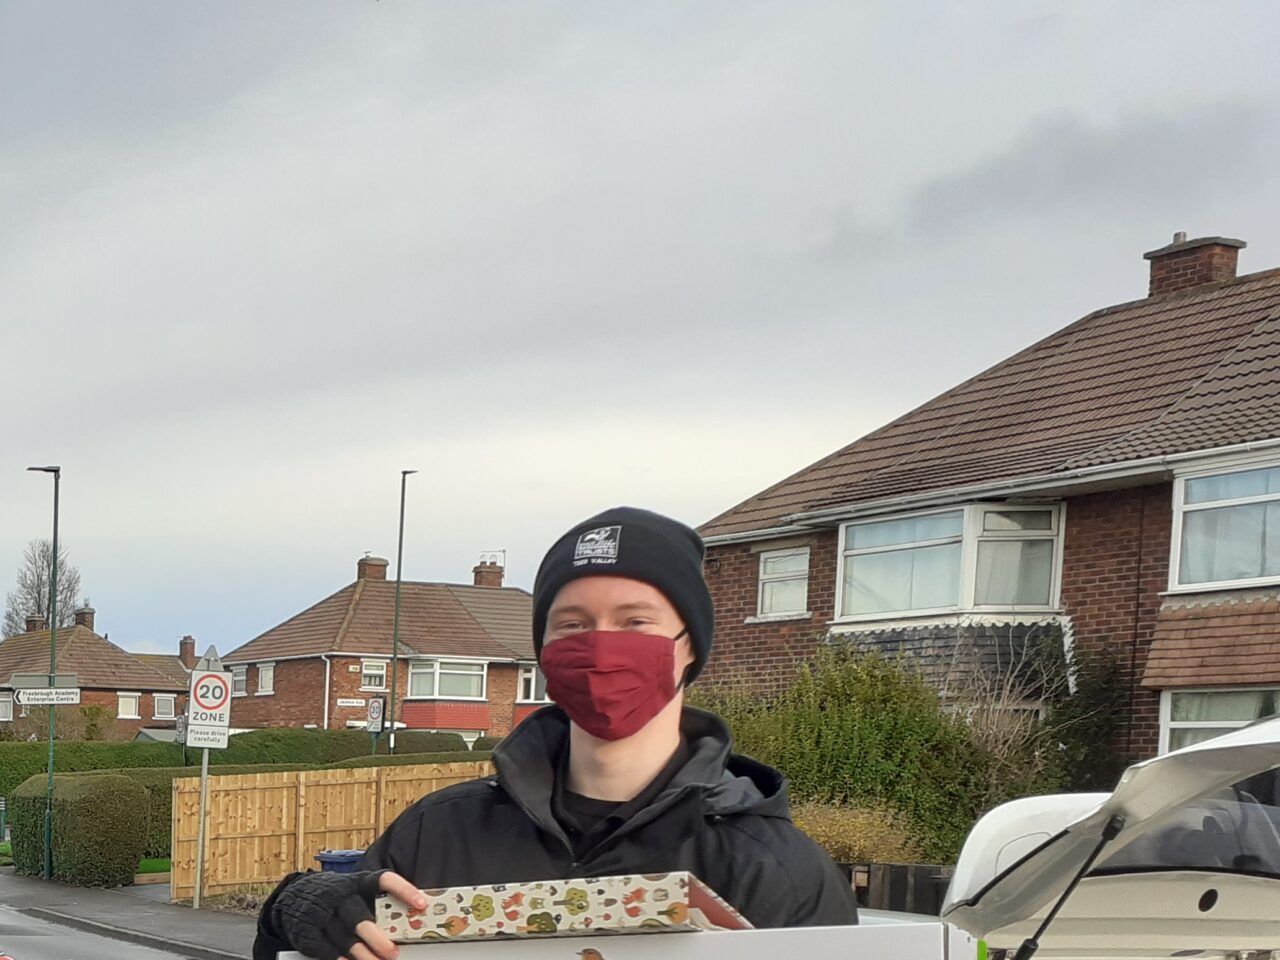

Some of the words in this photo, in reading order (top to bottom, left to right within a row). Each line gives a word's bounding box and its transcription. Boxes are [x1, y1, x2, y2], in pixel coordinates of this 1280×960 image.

[199, 684, 223, 700] 20
[192, 711, 225, 722] ZONE
[210, 729, 226, 737] drive
